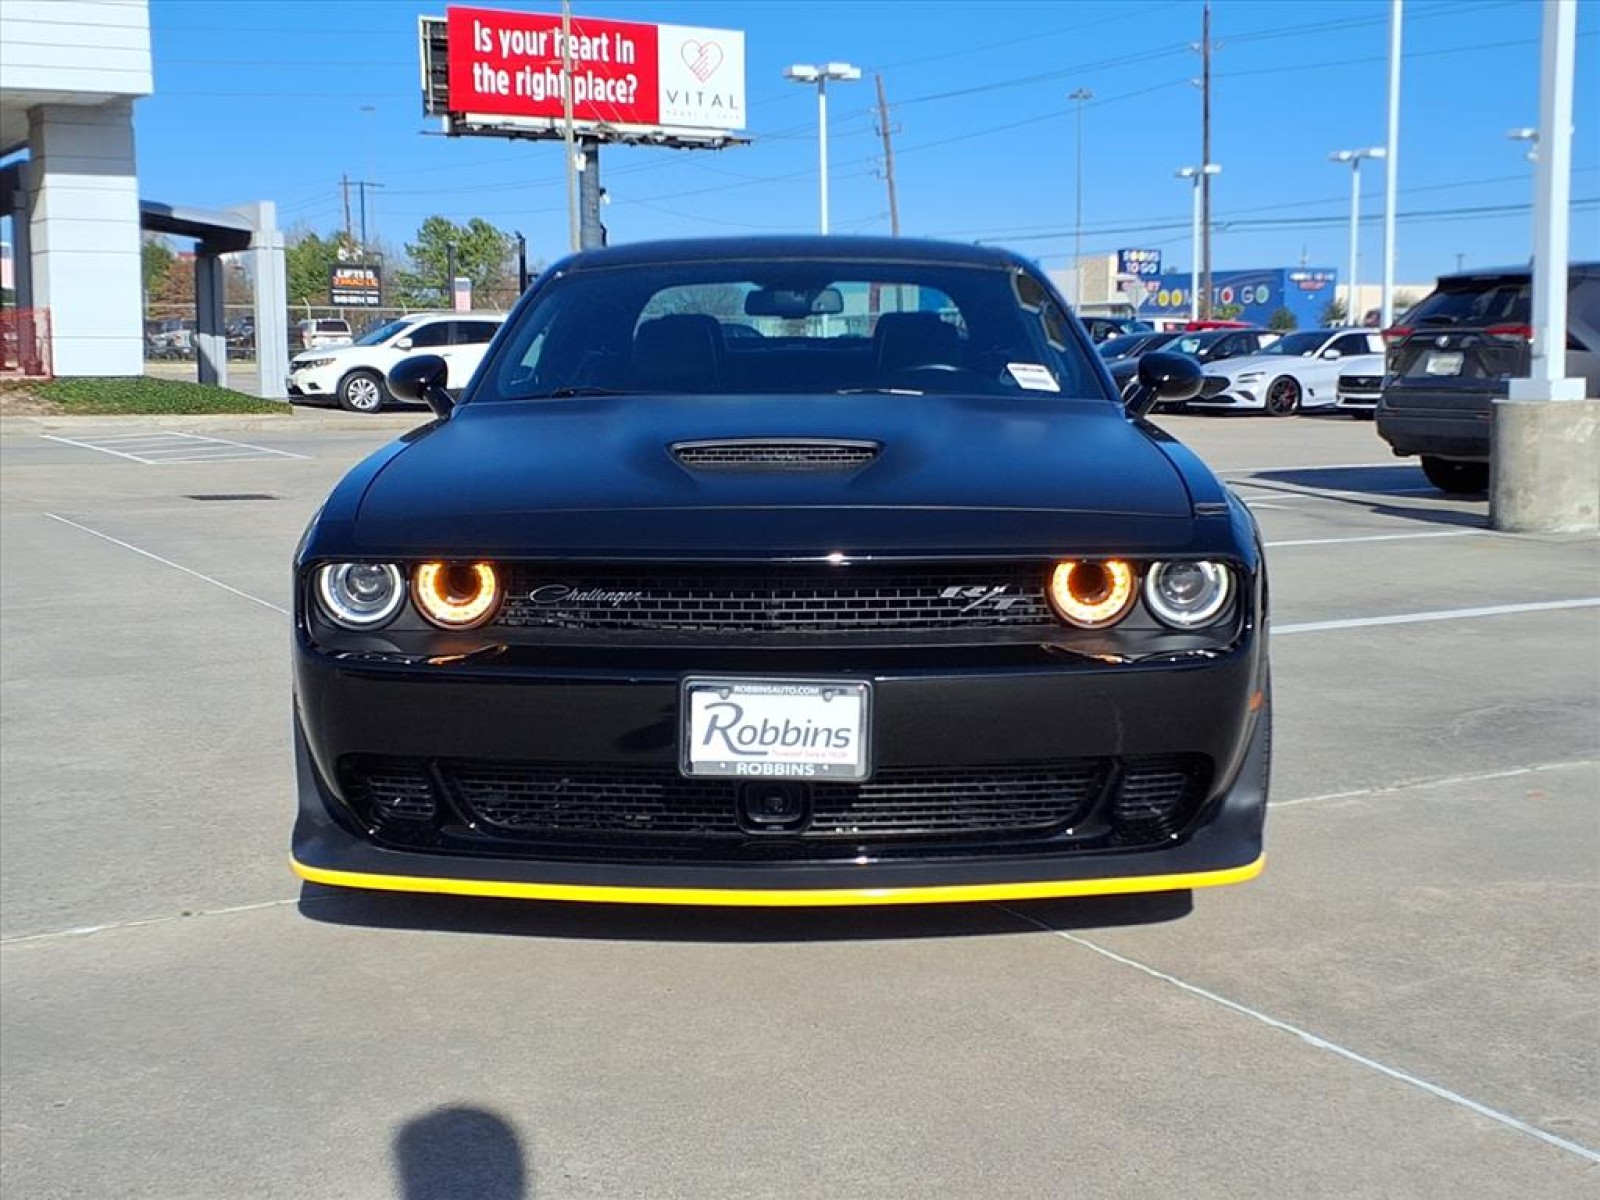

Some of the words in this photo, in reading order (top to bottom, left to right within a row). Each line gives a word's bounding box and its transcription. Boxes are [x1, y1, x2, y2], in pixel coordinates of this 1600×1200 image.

[473, 19, 493, 53] Is
[497, 28, 548, 59] your
[553, 26, 610, 62] heart
[615, 32, 635, 64] in
[473, 61, 510, 96] the
[573, 69, 638, 105] place?
[666, 88, 739, 109] VITAL
[1213, 285, 1234, 305] TO
[1241, 284, 1270, 304] GO
[529, 583, 642, 607] Challenger
[940, 583, 1025, 612] R/T
[733, 685, 820, 696] ROBBINSAUTO.COM
[702, 702, 852, 756] Robbins
[736, 762, 815, 776] ROBBINS
